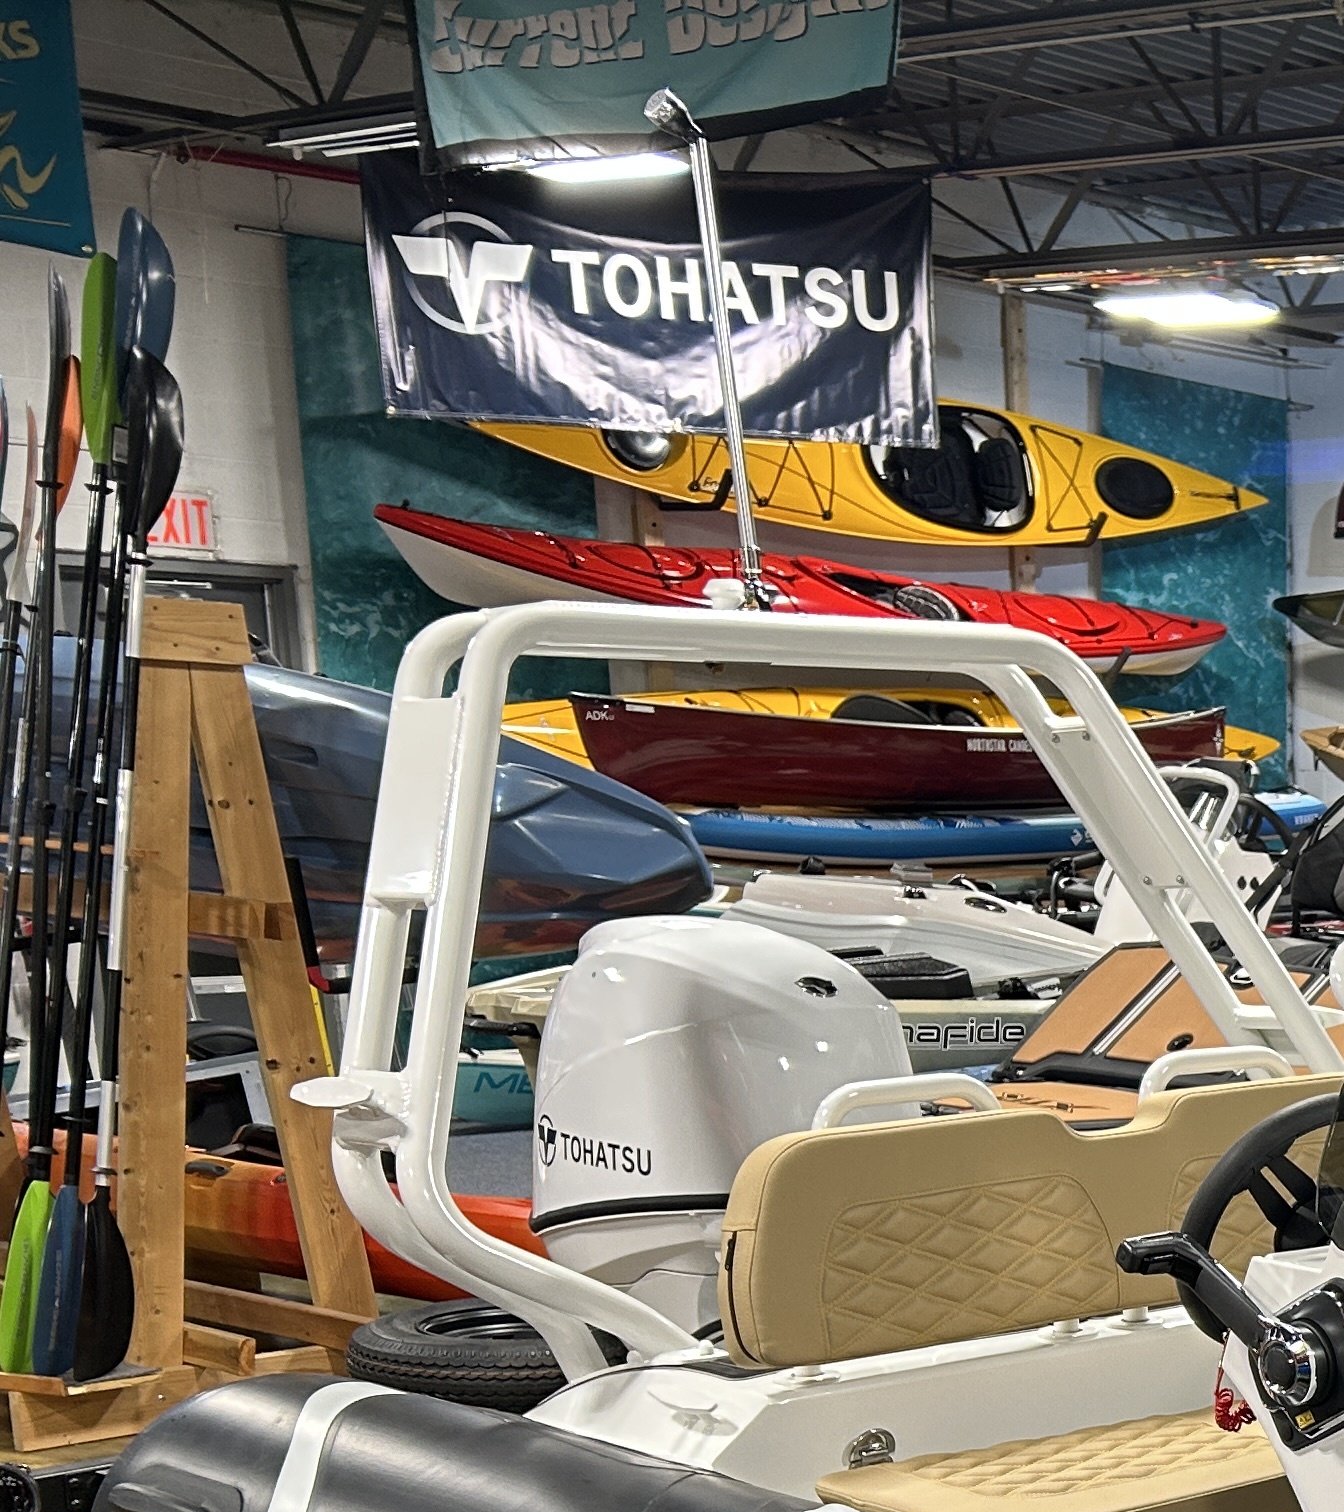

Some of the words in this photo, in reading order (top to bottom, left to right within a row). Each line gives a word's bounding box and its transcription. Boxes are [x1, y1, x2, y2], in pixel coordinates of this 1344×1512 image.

[551, 249, 898, 332] TOHATSU
[147, 498, 208, 546] XIT
[902, 1017, 1027, 1050] nafide
[560, 1131, 652, 1176] TOHATSU
